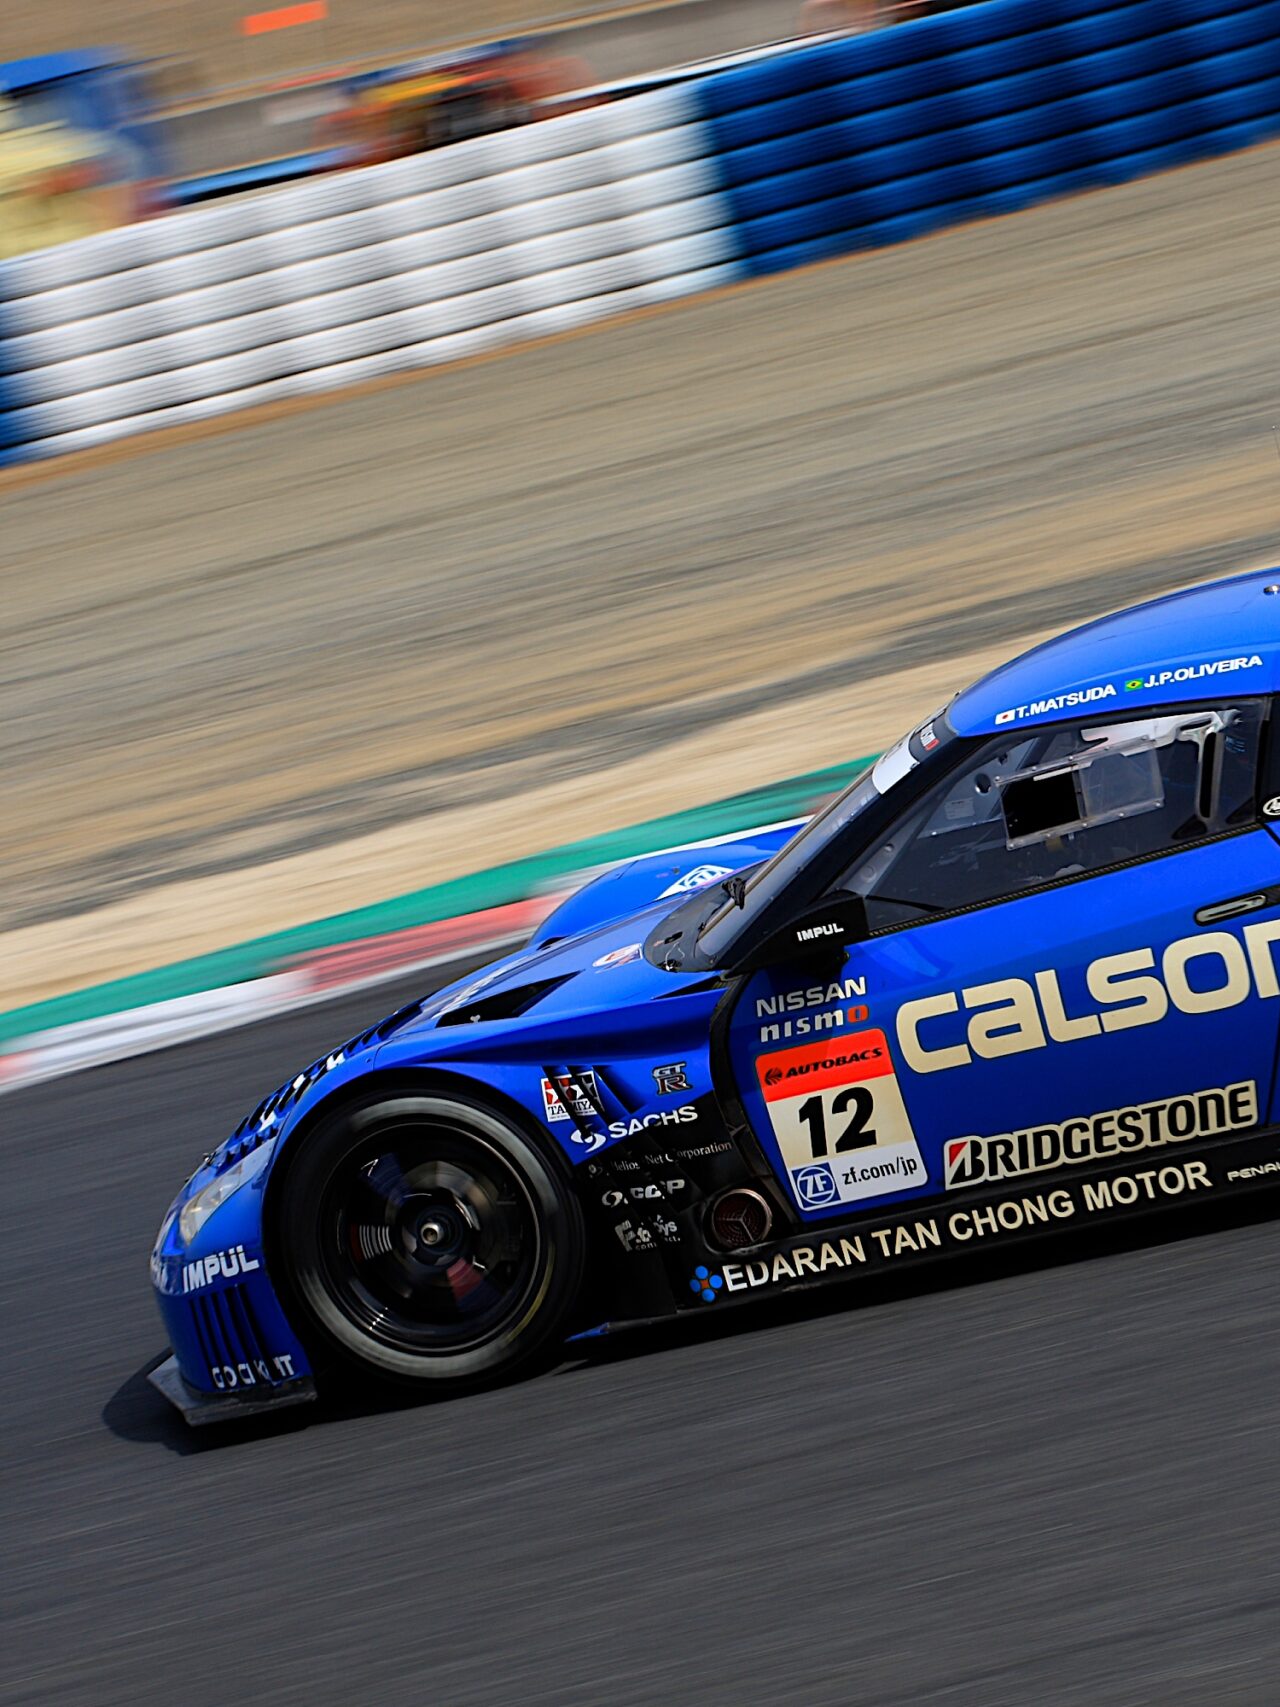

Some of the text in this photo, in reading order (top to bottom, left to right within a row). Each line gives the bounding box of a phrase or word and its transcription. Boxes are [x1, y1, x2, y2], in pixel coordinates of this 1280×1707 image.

[1143, 655, 1262, 689] J.P.OLIVEIRA
[1015, 684, 1117, 719] T.MATSUDA
[796, 922, 845, 941] IMPUL
[756, 976, 866, 1018] NISSAN
[785, 1047, 883, 1079] AUTOBACS
[608, 1106, 698, 1138] SACHS
[799, 1086, 877, 1159] 12
[949, 1084, 1254, 1186] BRIDGESTONE
[800, 1156, 918, 1200] ZF zf.com/jp
[722, 1161, 1213, 1292] EDARAN TAN CHONG MOTOR
